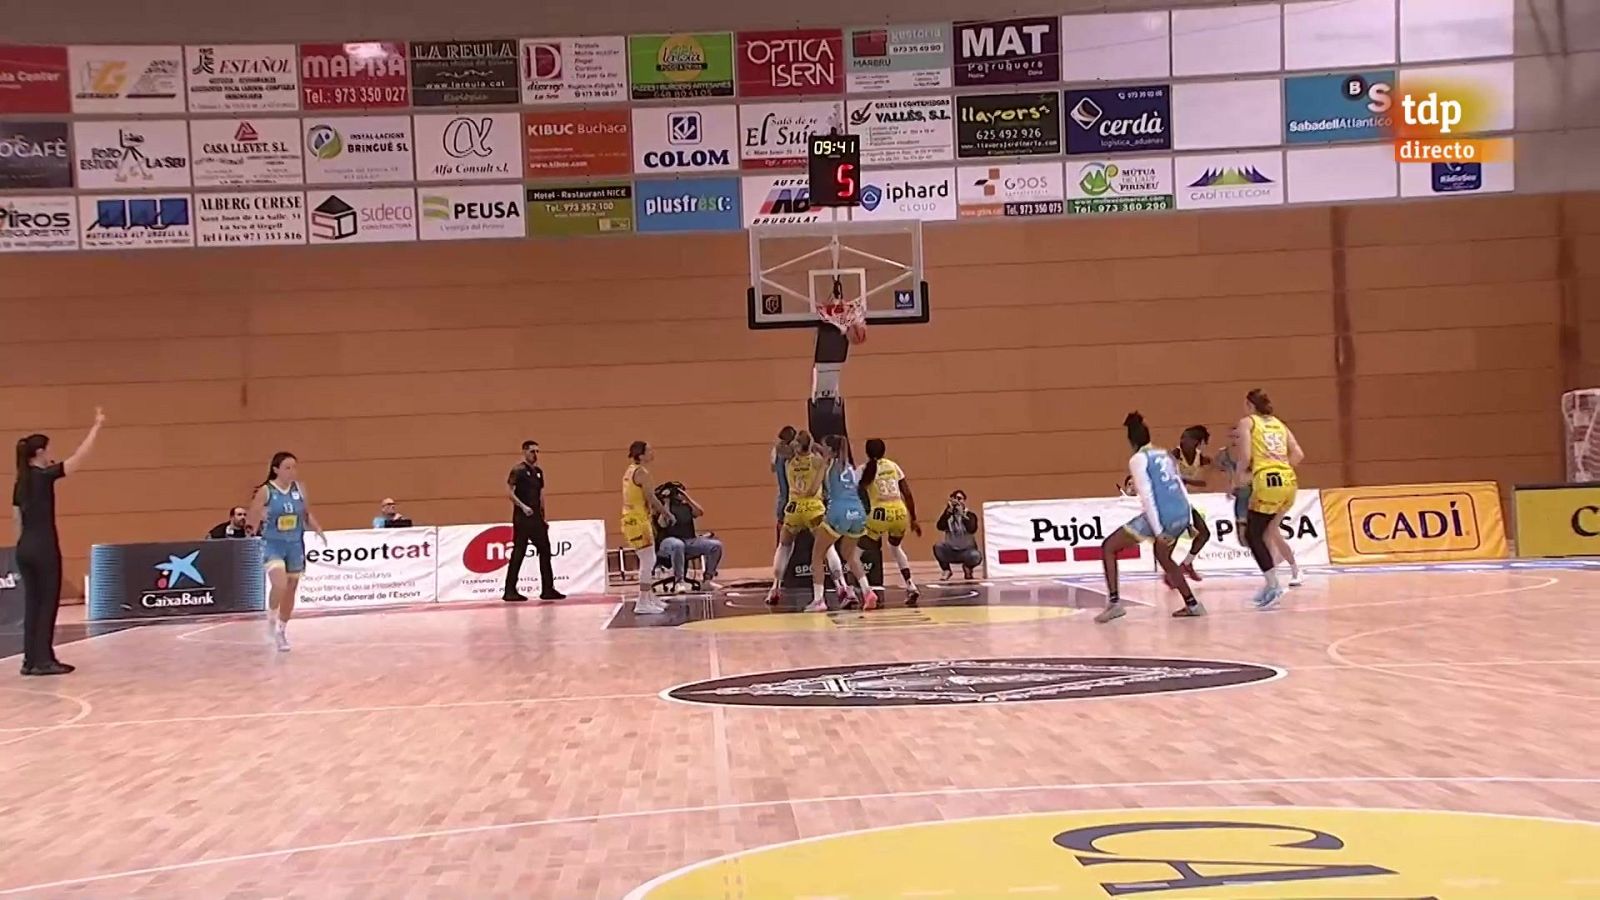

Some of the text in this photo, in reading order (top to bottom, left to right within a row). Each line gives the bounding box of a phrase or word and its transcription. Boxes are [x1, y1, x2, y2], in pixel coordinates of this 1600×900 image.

[961, 24, 1050, 58] MAT
[415, 42, 514, 60] LA REULA
[219, 56, 292, 73] ESTAÑOL
[302, 54, 406, 79] MAPISA
[771, 65, 835, 88] ISERN
[305, 86, 406, 103] Tel.: 973 350 027
[1349, 81, 1361, 95] B
[1368, 83, 1392, 113] S
[528, 121, 627, 136] KIBUC Buchaca
[746, 112, 776, 147] El
[1100, 111, 1165, 137] cerdà
[975, 127, 1042, 140] 625 492 926
[91, 147, 122, 159] FOTO
[203, 145, 228, 154] CASA
[396, 142, 410, 152] SL
[813, 140, 855, 155] 09:41
[145, 158, 163, 169] LA
[165, 156, 186, 168] SEU
[644, 149, 730, 168] COLOM
[432, 163, 454, 175] Alfa
[456, 162, 494, 173] Consult
[837, 164, 854, 198] 5
[534, 188, 627, 200] Hotel Restaurant NICE
[886, 183, 949, 205] iphard
[1220, 189, 1270, 199] TELECOM
[200, 195, 303, 211] ALBERG CERESE
[454, 201, 520, 220] PEUSA
[581, 202, 597, 211] 352
[599, 201, 614, 210] 100
[899, 204, 936, 216] CLOUD
[1020, 204, 1033, 214] 973
[1034, 202, 1047, 213] 350
[1098, 204, 1119, 212] 973
[361, 203, 413, 222] sideco
[1031, 516, 1105, 552] Pujol
[1215, 515, 1319, 542] PSA
[306, 541, 431, 566] esportcat
[142, 592, 214, 608] CaixaBank
[343, 591, 375, 601] General
[377, 591, 387, 599] de
